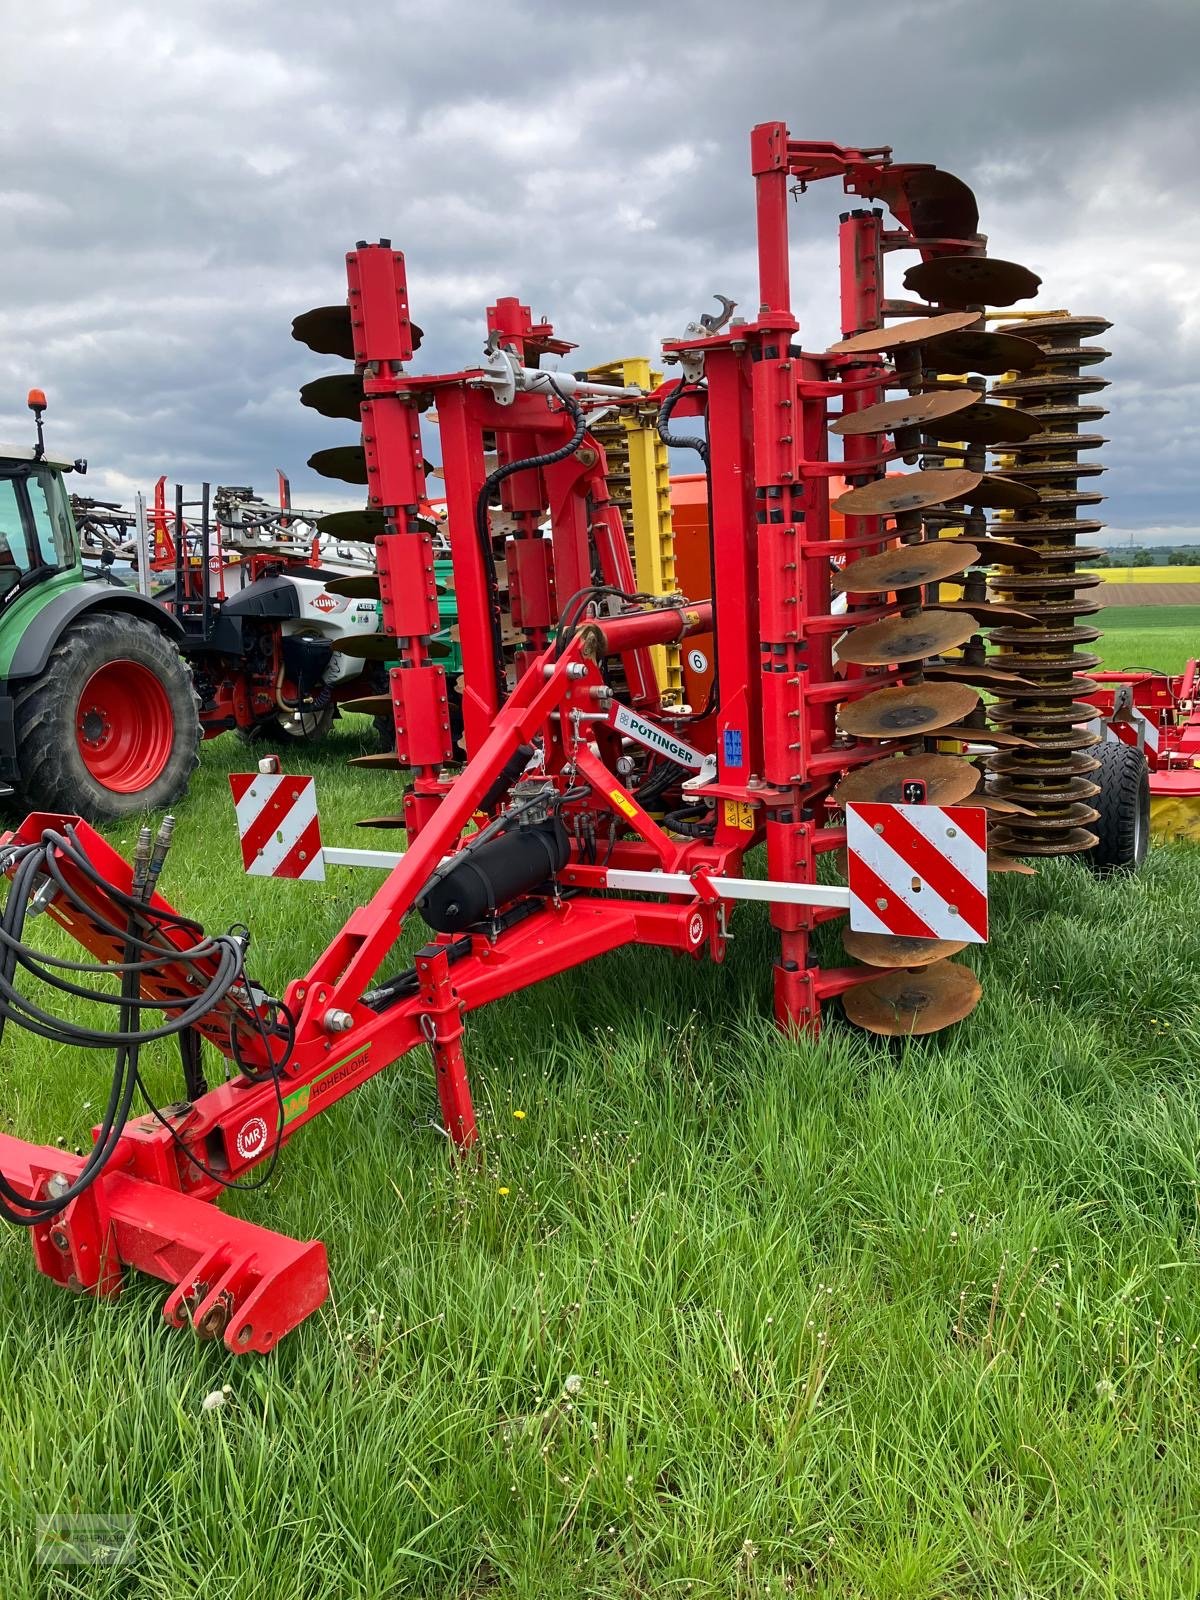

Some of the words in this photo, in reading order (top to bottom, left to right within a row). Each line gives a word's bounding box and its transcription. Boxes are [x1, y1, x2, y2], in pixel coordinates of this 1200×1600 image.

[312, 599, 336, 607] KUHN
[693, 654, 702, 668] 6
[312, 1053, 369, 1097] HOHENLOHE
[244, 1129, 261, 1148] MR
